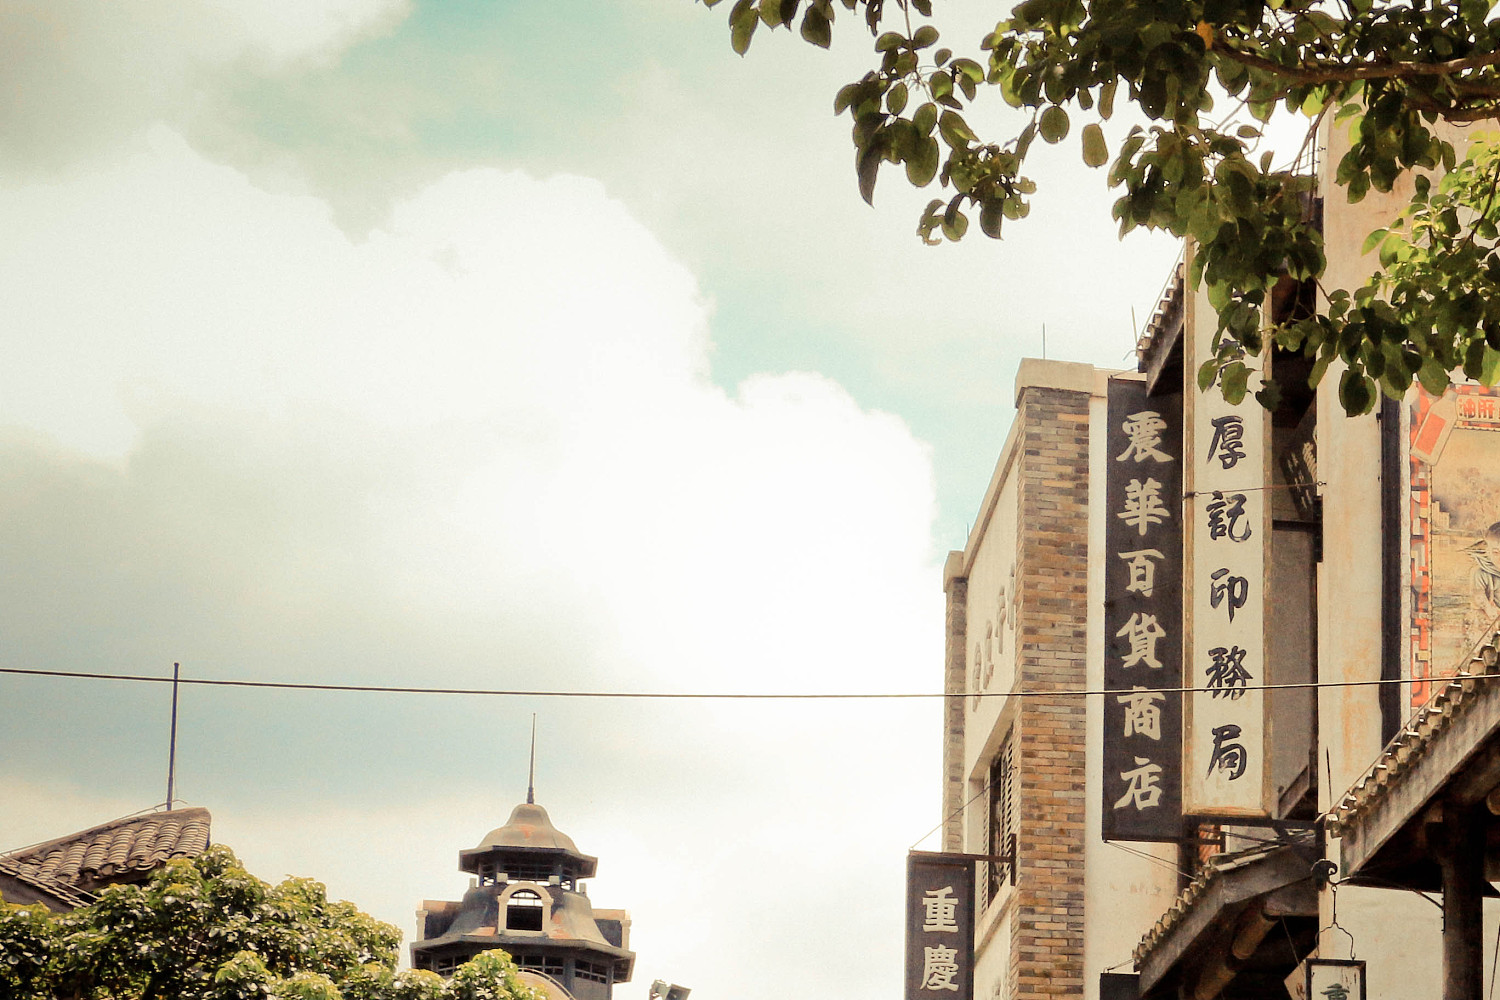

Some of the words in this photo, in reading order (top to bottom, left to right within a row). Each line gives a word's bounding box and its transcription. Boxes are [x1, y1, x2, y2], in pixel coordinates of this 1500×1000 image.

[1113, 410, 1175, 812] 震華百貨商店
[1203, 338, 1253, 782] 厚記印務局
